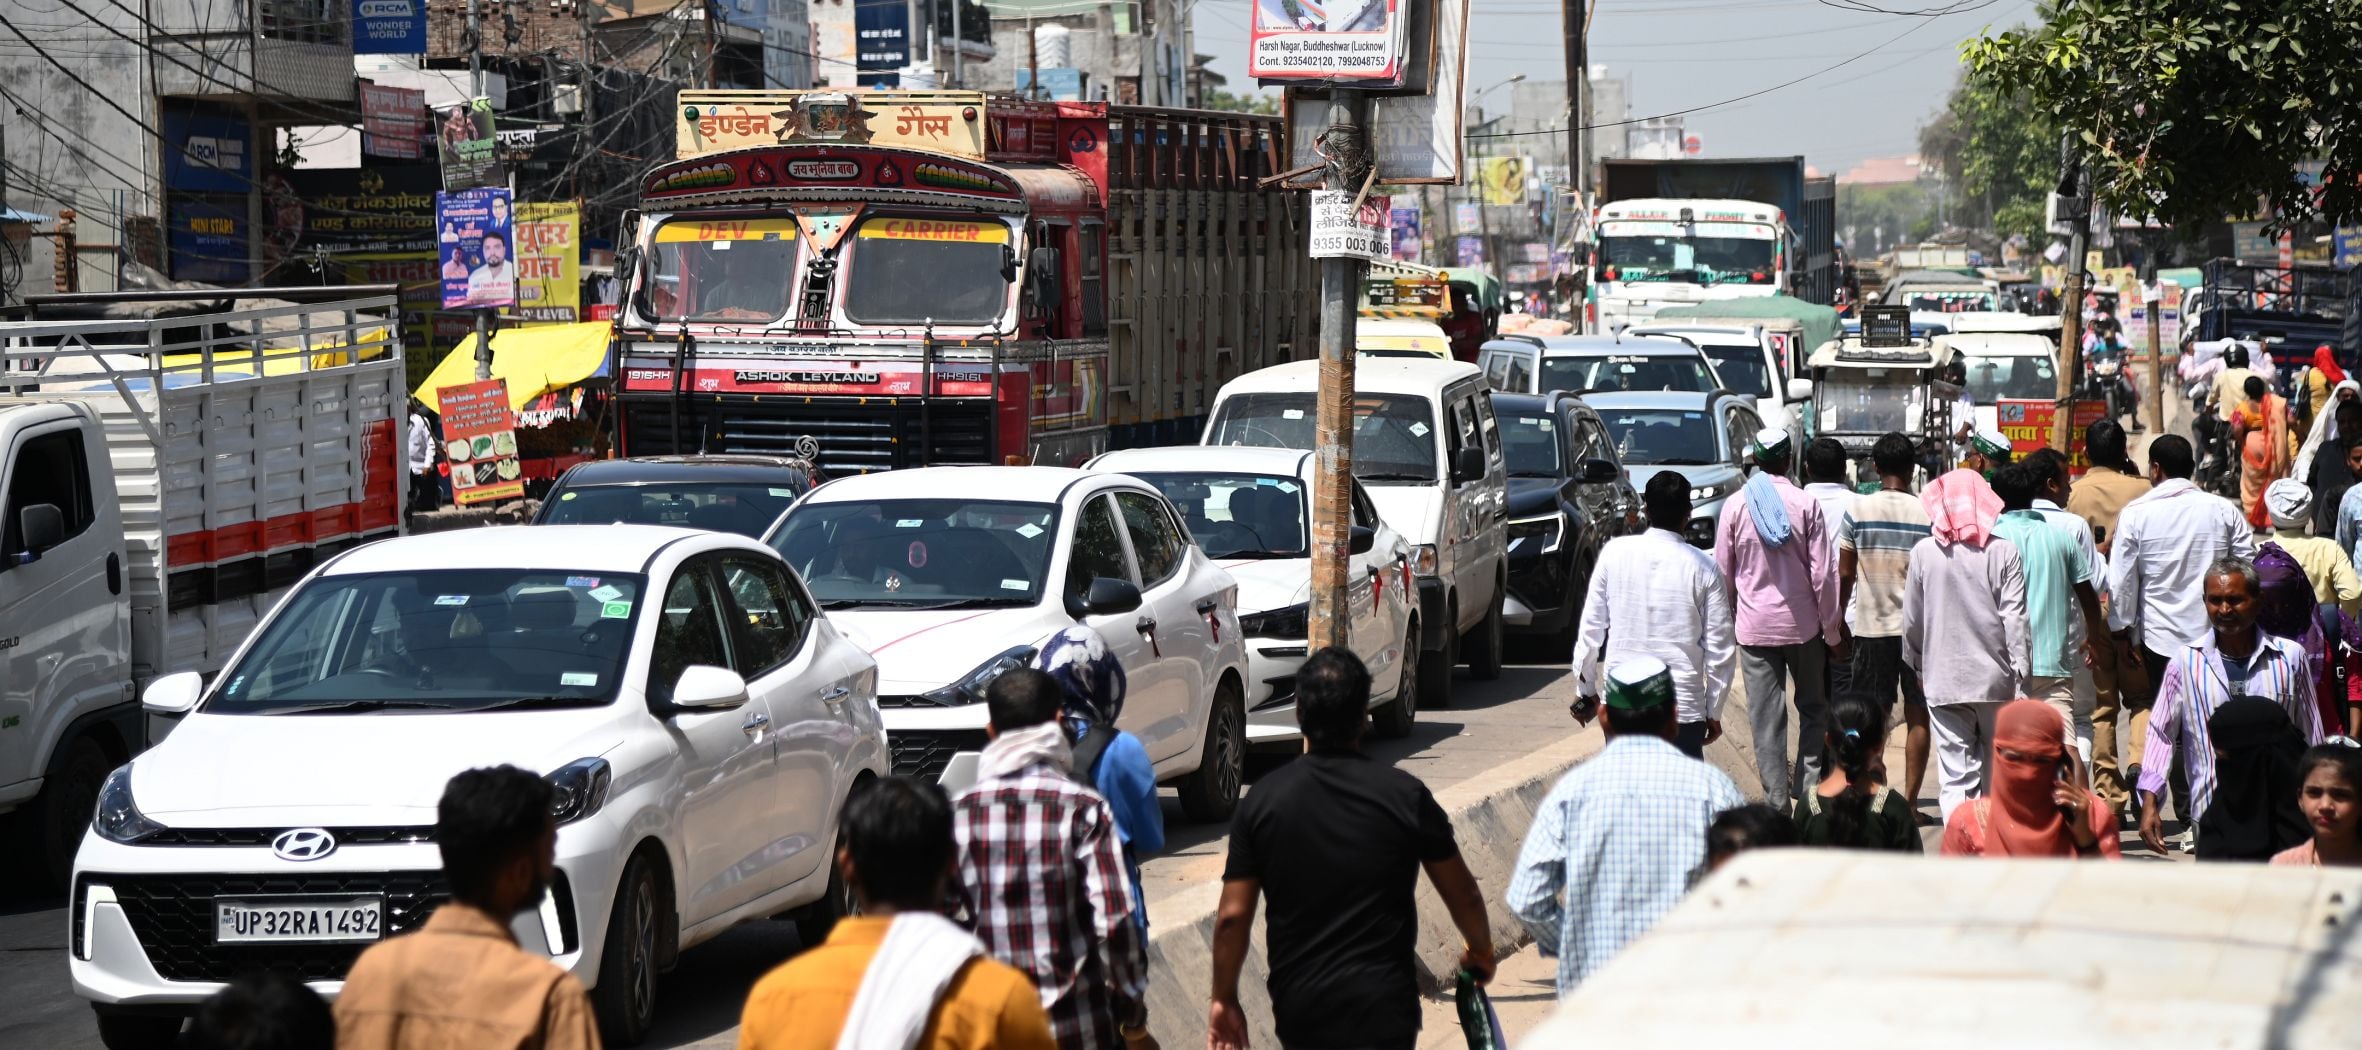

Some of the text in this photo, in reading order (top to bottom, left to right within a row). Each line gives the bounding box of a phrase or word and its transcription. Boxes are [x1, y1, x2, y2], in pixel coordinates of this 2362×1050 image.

[374, 4, 409, 13] RCM
[366, 21, 412, 31] WONDER
[368, 30, 408, 39] WORLD
[1259, 39, 1386, 54] Harsh Nagar, Buddheshwar (Lucknow)
[1259, 55, 1386, 68] Cont. 9235402120, 7992048753
[896, 106, 953, 143] गैस
[196, 144, 217, 161] RCM
[793, 163, 807, 175] जय
[210, 218, 235, 235] STARS
[699, 221, 749, 241] DEV
[884, 220, 981, 241] CARRIER
[1313, 236, 1390, 255] 9355 003 006
[536, 306, 573, 320] LEVEL
[627, 370, 671, 380] 1916HH
[735, 370, 879, 383] ASHOK LEYLAND
[699, 378, 720, 392] शुभ
[0, 636, 20, 650] GOLD
[235, 908, 379, 936] UP32RA1492
